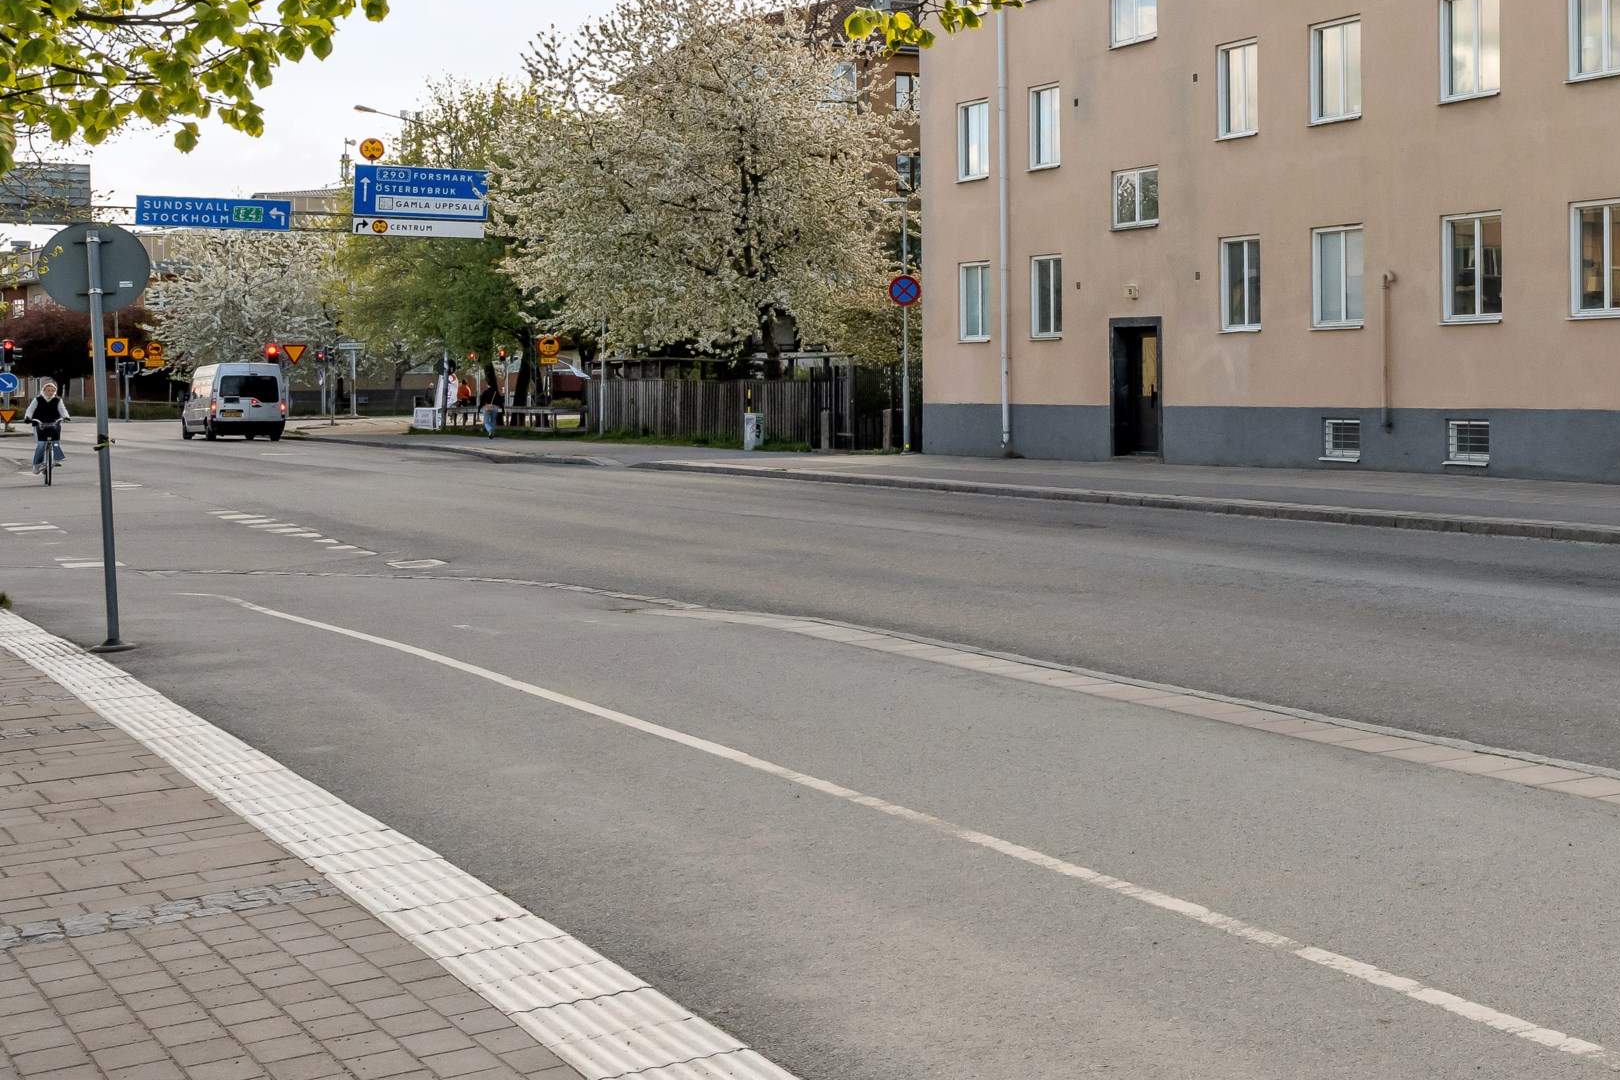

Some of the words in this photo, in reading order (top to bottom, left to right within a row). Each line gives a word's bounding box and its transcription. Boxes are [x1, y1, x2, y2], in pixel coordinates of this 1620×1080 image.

[382, 170, 405, 179] 290
[413, 172, 473, 182] FORSMARK
[375, 183, 456, 195] ÖSTERBYBRUK
[143, 200, 230, 211] SUNDSVALL
[395, 200, 431, 209] GAMLA
[434, 202, 480, 211] UPPSALA
[142, 212, 230, 224] STOCKHOLM
